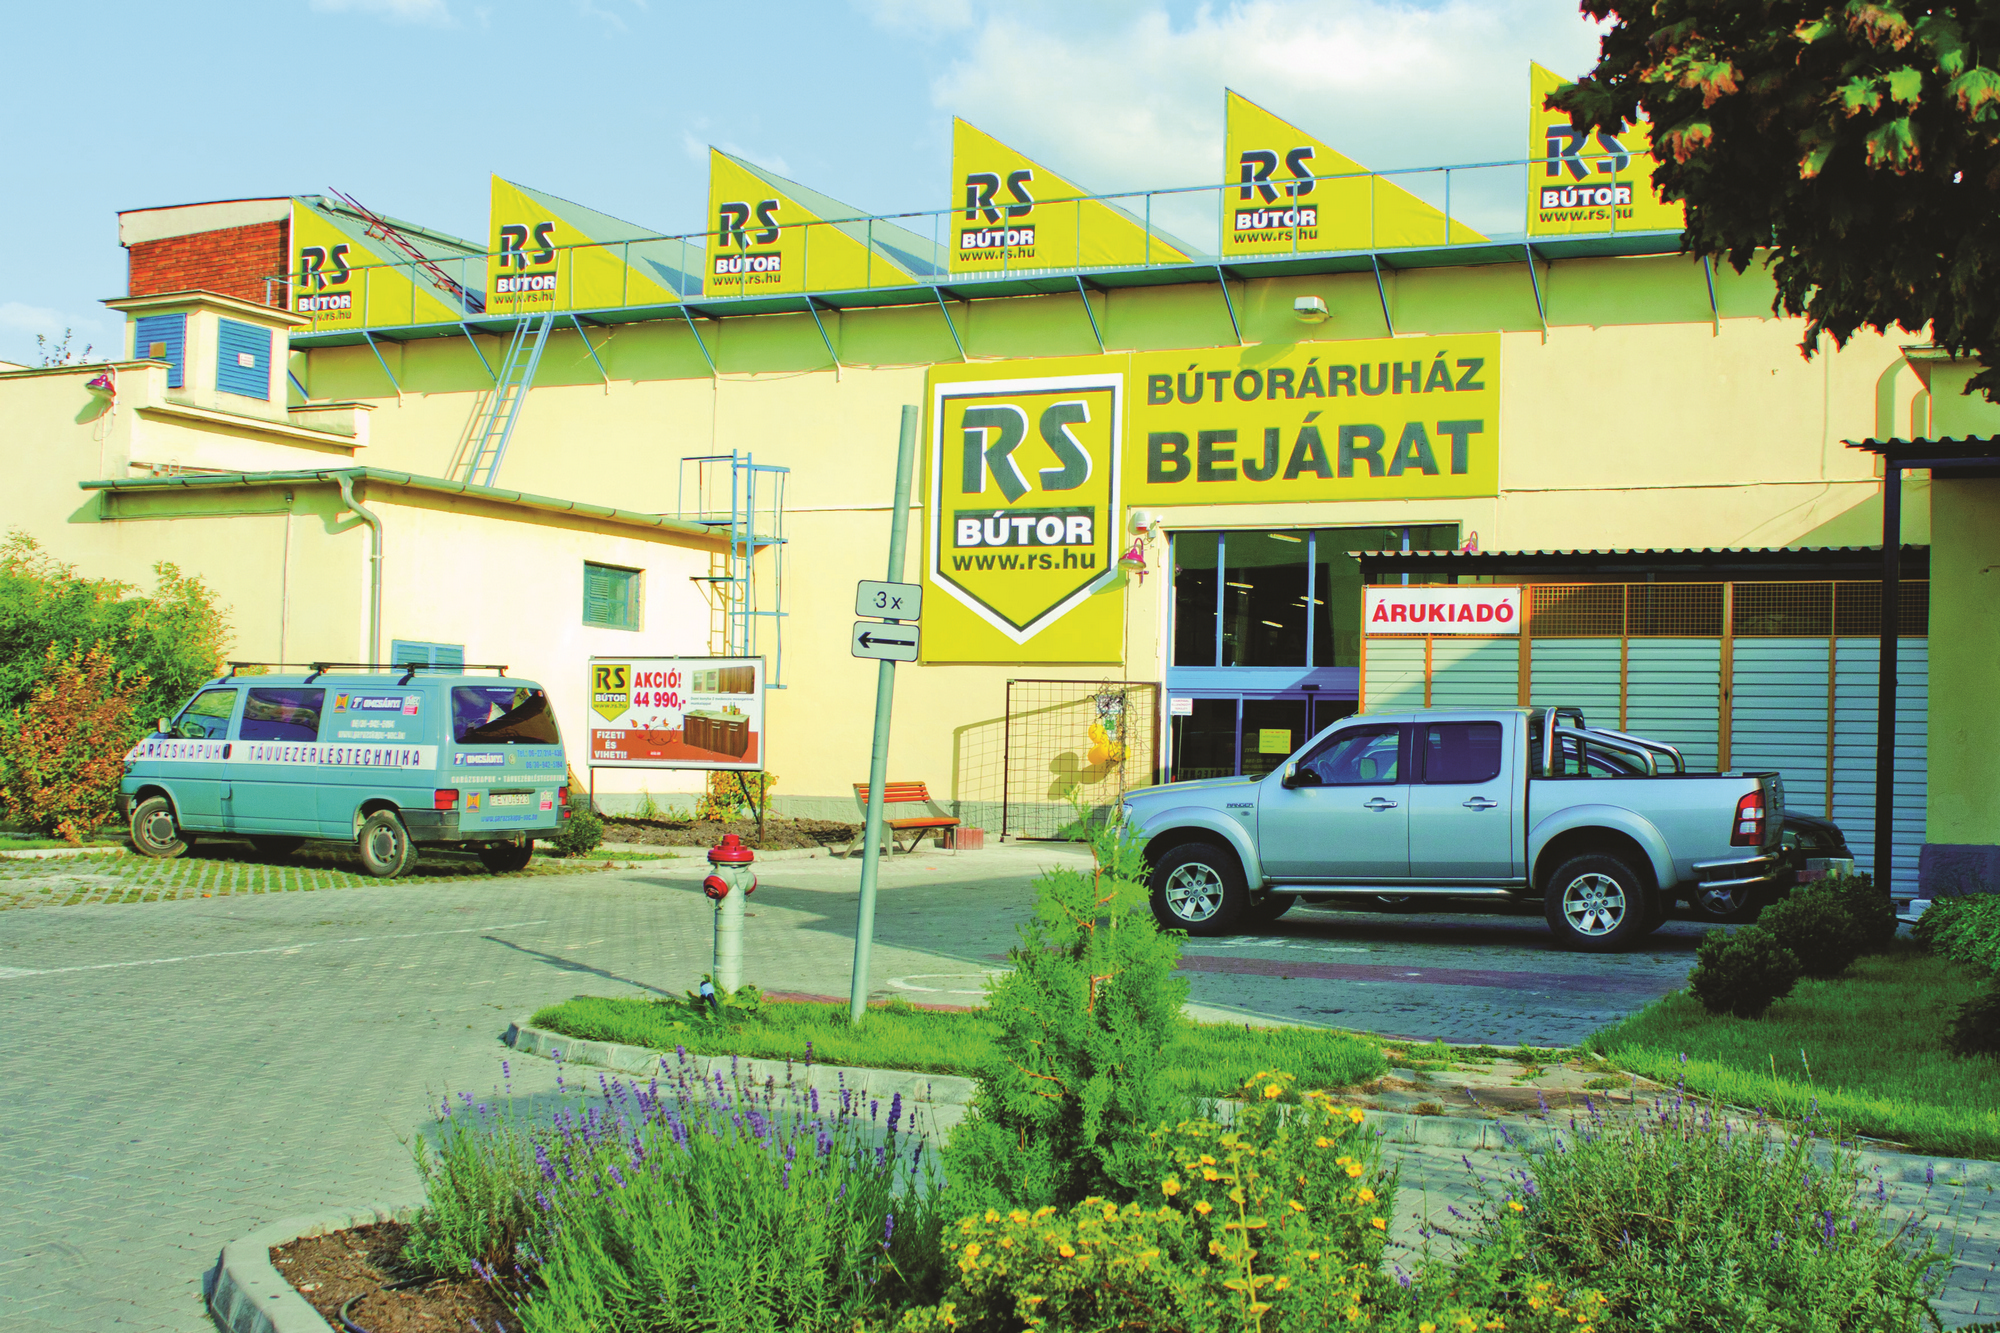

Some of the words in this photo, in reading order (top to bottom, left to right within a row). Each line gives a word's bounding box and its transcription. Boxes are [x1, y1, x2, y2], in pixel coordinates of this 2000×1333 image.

[1545, 116, 1631, 182] RS
[1239, 146, 1316, 205] RS
[965, 169, 1034, 225] RS
[1541, 186, 1632, 209] BÚTOR
[719, 199, 781, 251] RS
[1236, 208, 1316, 230] BÚTOR
[500, 221, 556, 271] RS
[962, 228, 1034, 249] BÚTOR
[1234, 228, 1318, 244] www.rshu
[715, 254, 780, 274] BÚTOR
[959, 247, 1035, 262] www.rs.hu
[300, 243, 352, 292] RS
[713, 273, 781, 286] www.rs.hu
[1146, 350, 1486, 405] BÚTORÁRUHÁZ
[961, 401, 1093, 504] RS
[1146, 411, 1485, 484] BEJÁRAT
[956, 511, 1093, 547] BÚTOR
[953, 548, 1096, 572] www.rs.hu
[1372, 598, 1514, 624] ÁRUKIADÓ
[597, 667, 626, 691] RS
[634, 668, 682, 688] AKCIÓ!
[595, 693, 627, 702] BÚTOR
[633, 692, 650, 708] 44
[597, 731, 625, 739] FIZETI
[604, 740, 617, 749] ÉS
[594, 750, 627, 759] VIHETI!
